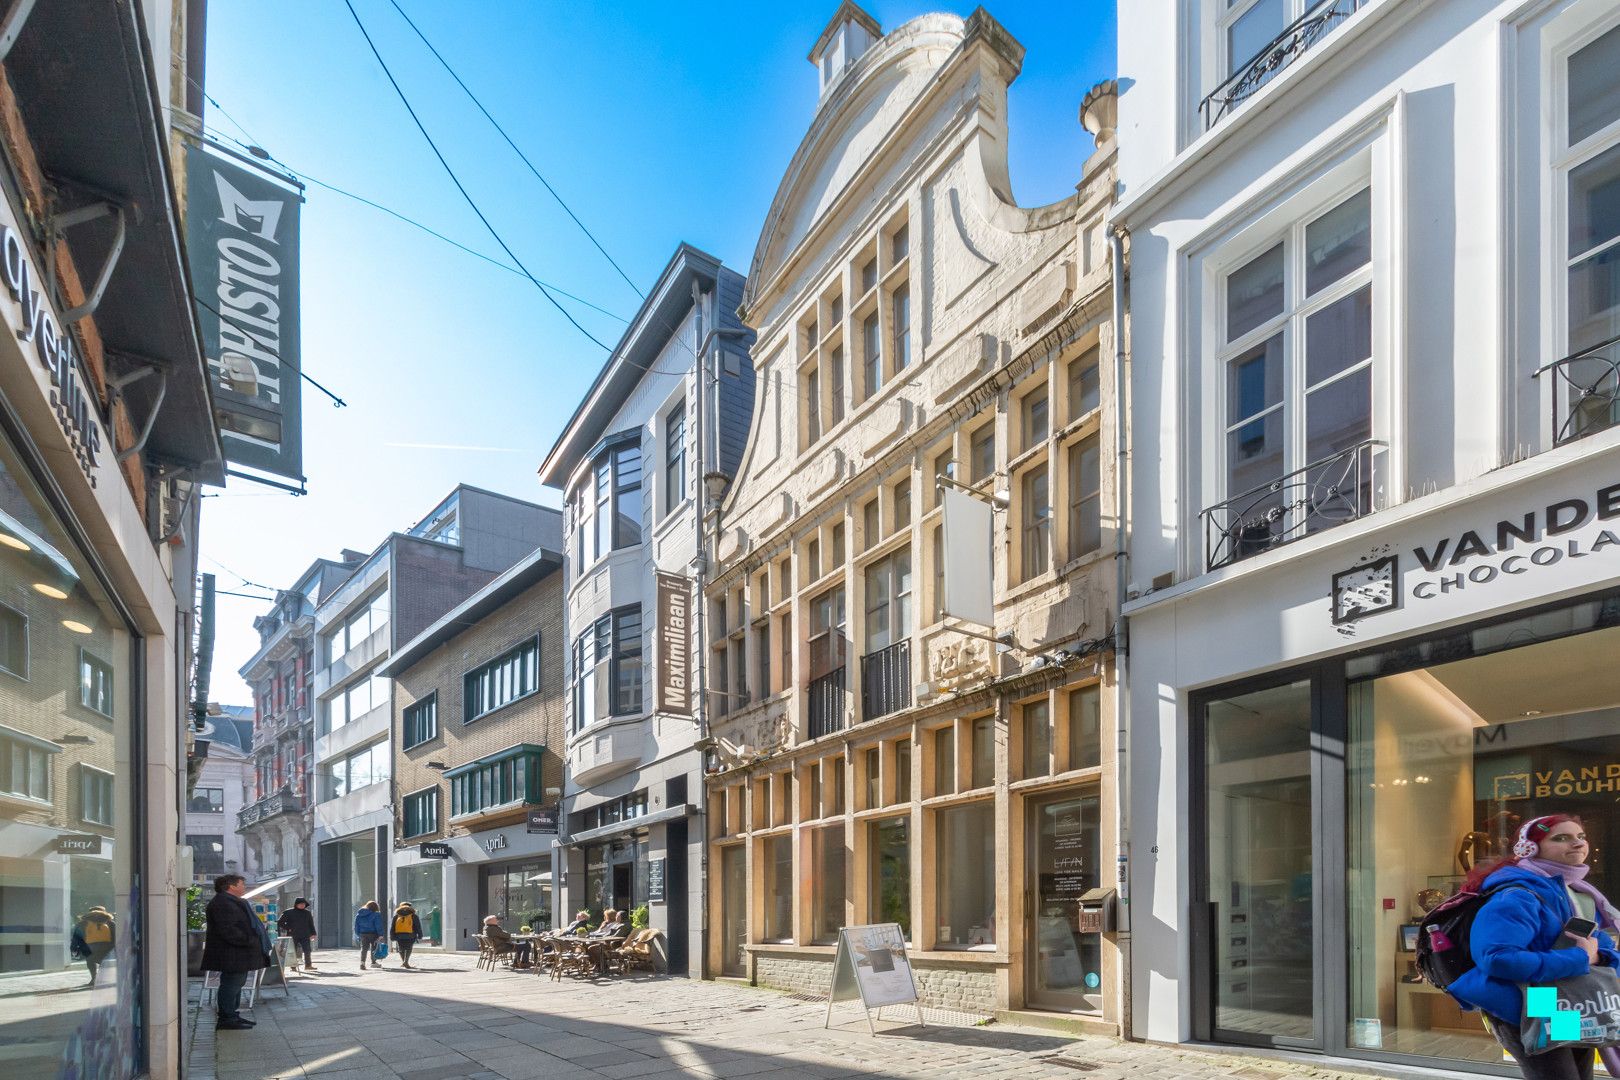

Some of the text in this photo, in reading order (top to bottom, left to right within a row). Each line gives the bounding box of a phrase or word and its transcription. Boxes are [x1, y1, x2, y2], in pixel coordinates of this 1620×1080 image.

[1413, 530, 1620, 599] CHOCOLA
[664, 593, 686, 708] Maximiliaan
[1150, 845, 1159, 854] 46
